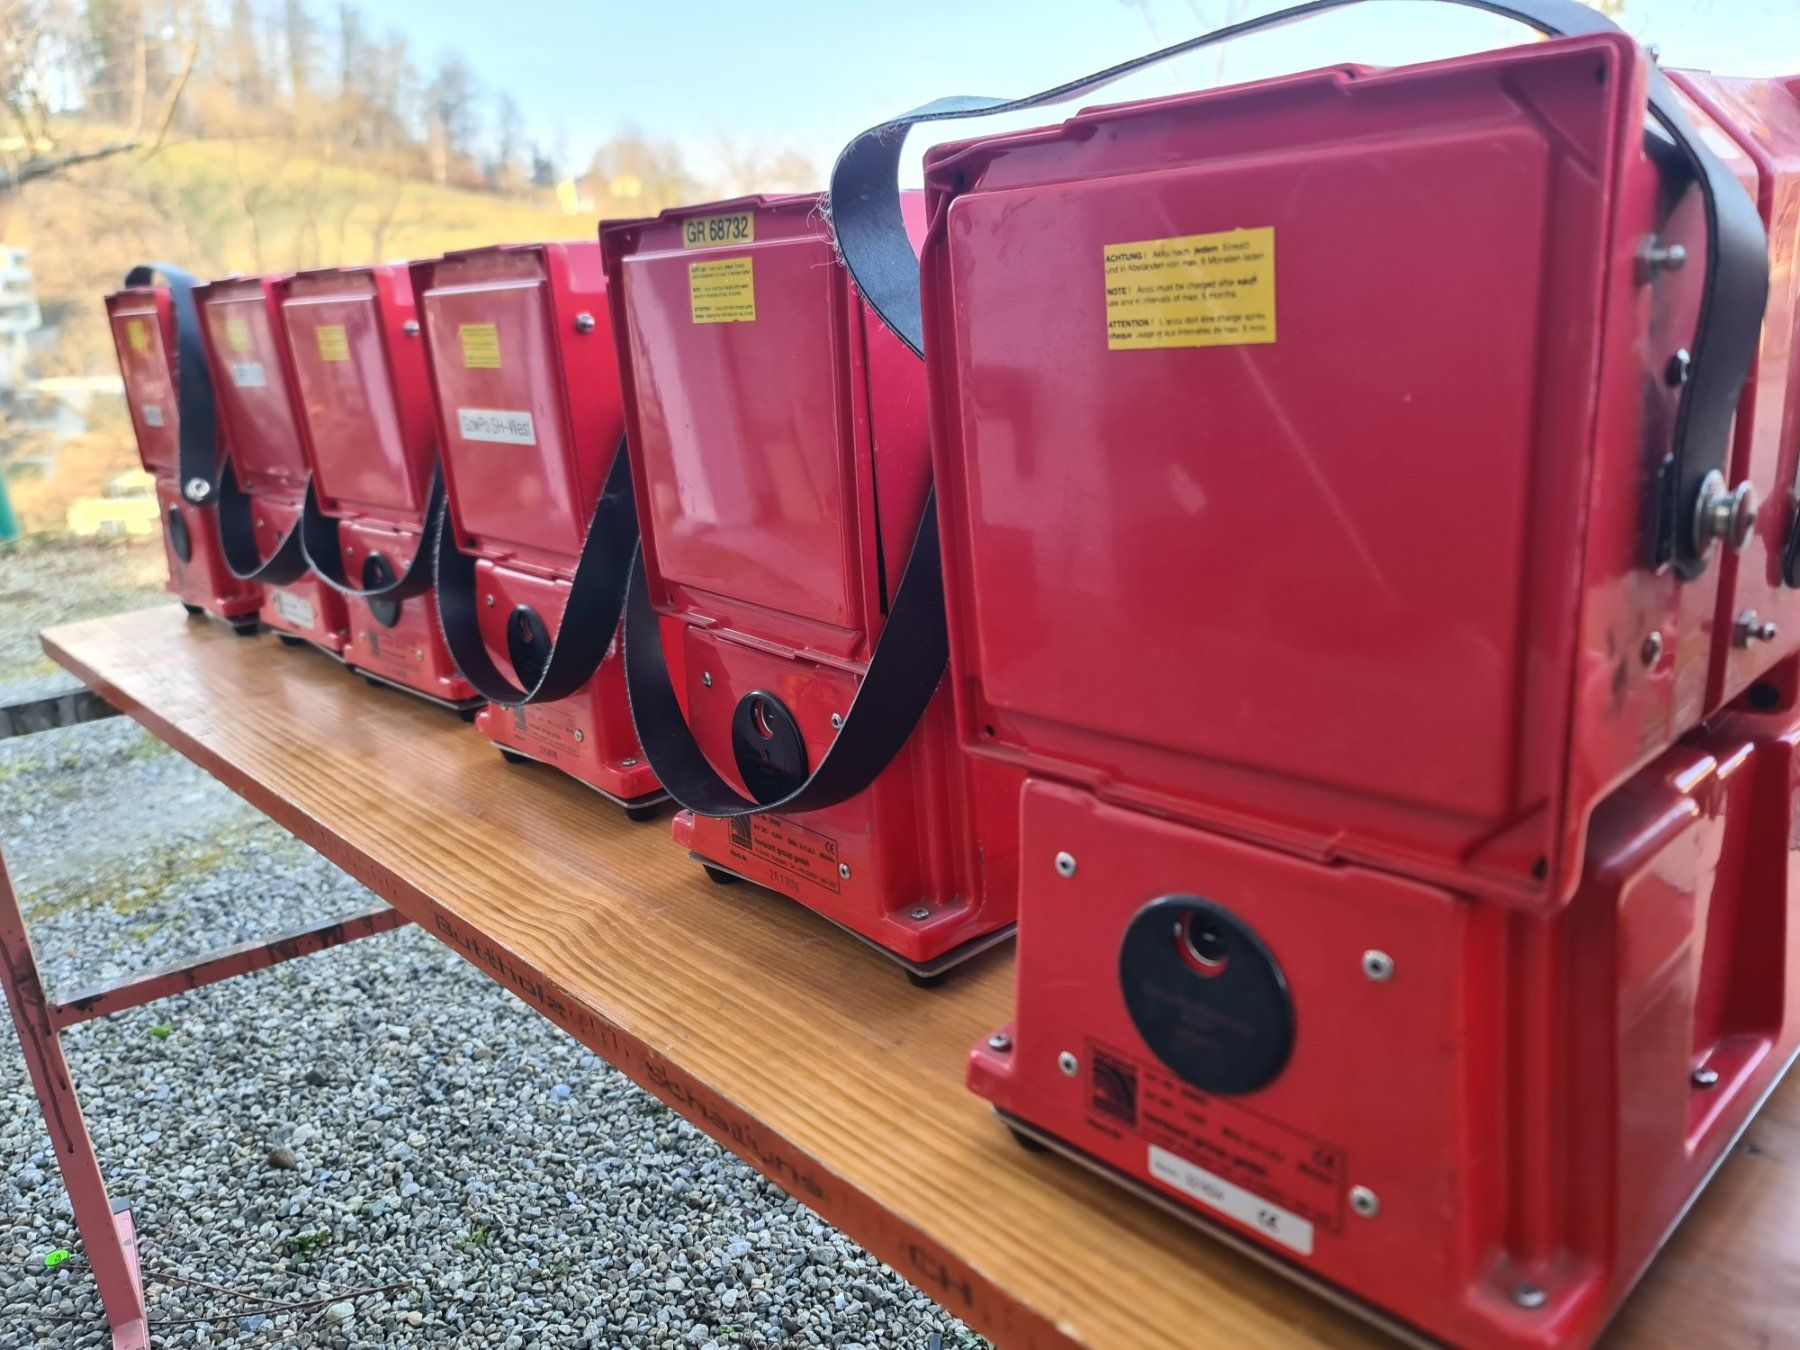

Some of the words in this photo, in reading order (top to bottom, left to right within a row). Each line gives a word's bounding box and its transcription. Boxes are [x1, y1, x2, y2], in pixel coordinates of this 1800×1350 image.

[686, 222, 706, 243] GR
[709, 216, 749, 241] 68732
[1106, 251, 1142, 262] ACHTUNG
[1107, 287, 1127, 296] NOTE
[1109, 319, 1149, 328] ATTENTION
